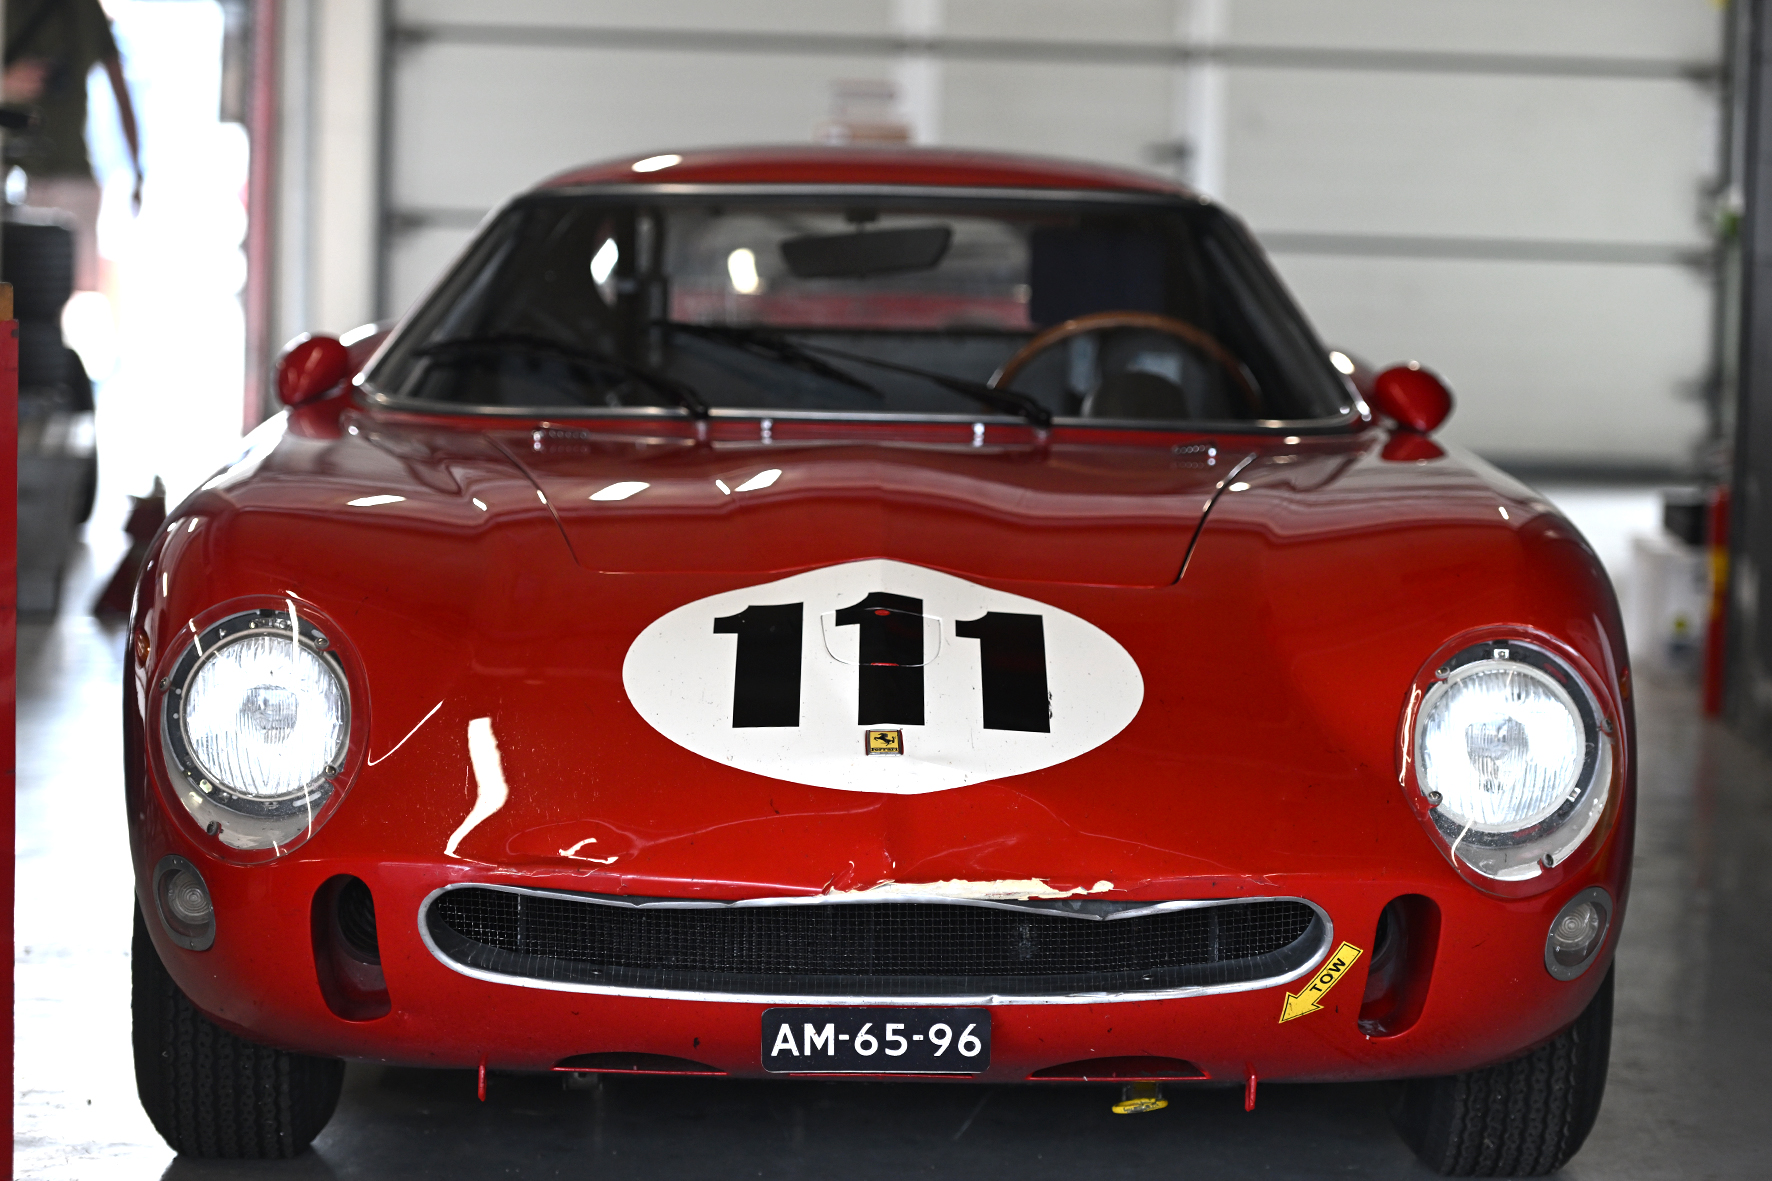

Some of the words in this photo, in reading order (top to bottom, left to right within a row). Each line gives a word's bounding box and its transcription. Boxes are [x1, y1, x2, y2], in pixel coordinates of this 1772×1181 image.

[713, 591, 1051, 733] 111
[1309, 957, 1346, 992] TOW
[770, 1022, 982, 1058] AM-65-96
